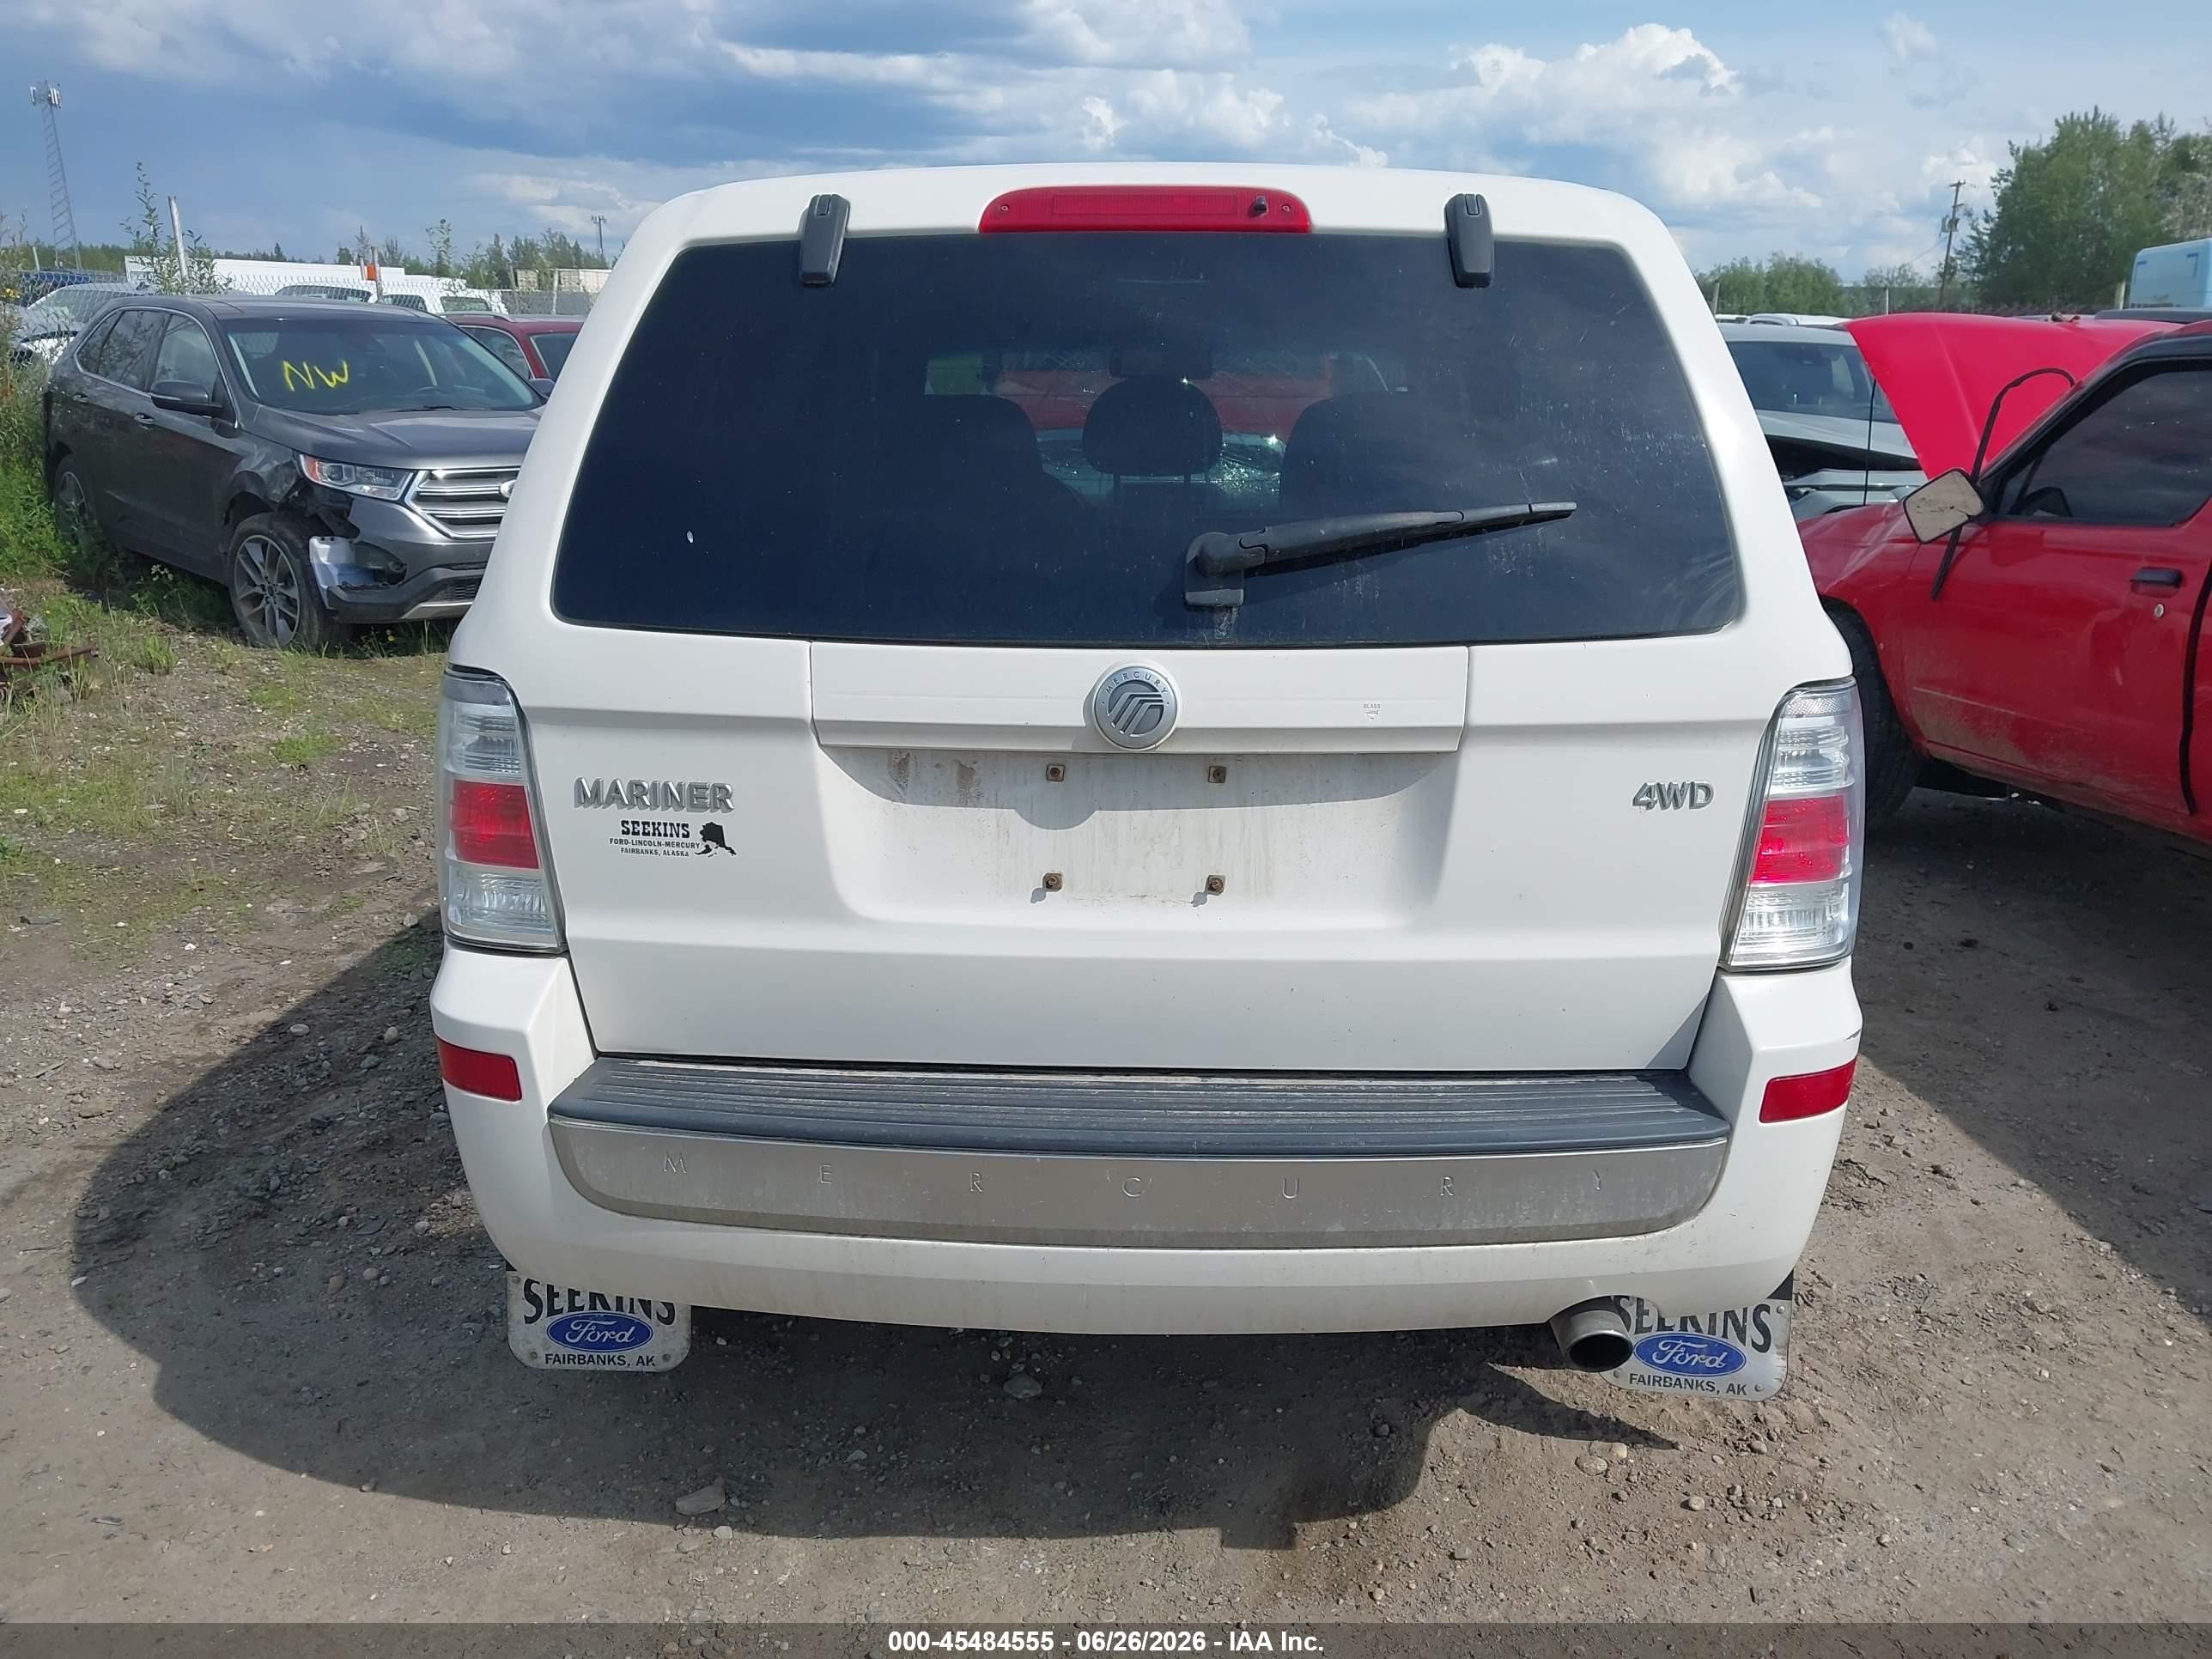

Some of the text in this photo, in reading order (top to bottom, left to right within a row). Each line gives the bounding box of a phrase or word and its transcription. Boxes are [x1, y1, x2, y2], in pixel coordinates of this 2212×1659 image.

[283, 360, 349, 392] NW
[1105, 671, 1169, 695] MERCURY
[574, 777, 734, 813] MARINER
[1632, 781, 1714, 811] 4WD
[621, 820, 690, 839] SEEKINS
[609, 838, 701, 849] FORD-LINCOLN-MERCURY
[621, 848, 660, 857] FAIRBANKS,
[564, 1319, 636, 1344] Ford
[545, 1353, 656, 1368] FAIRBANKS, AK
[1652, 1340, 1728, 1370] Ford
[1629, 1372, 1748, 1395] FAIRBANKS, AK
